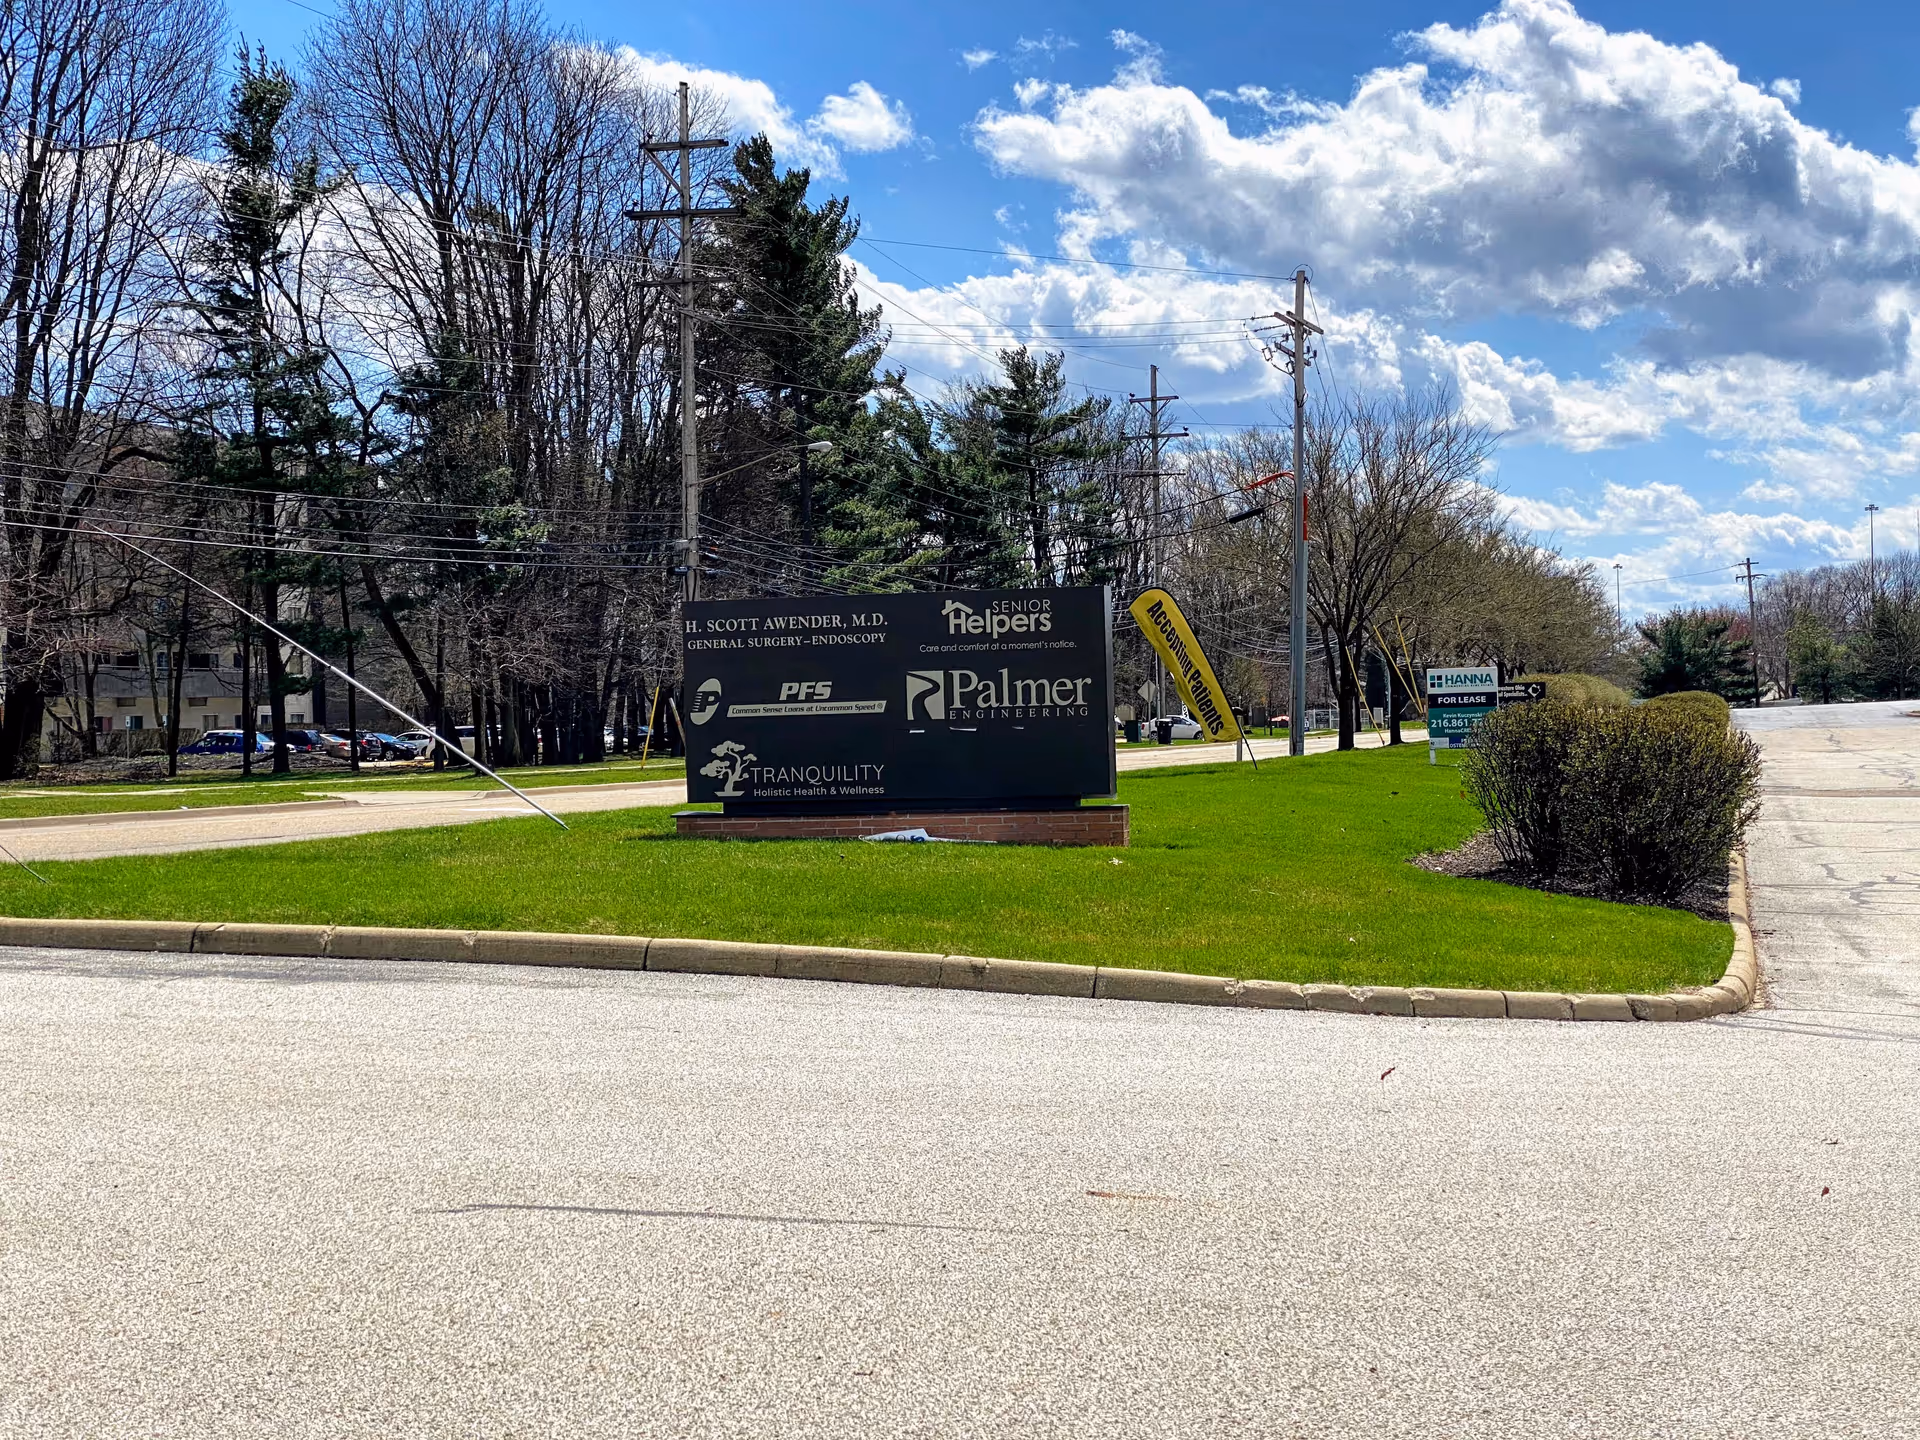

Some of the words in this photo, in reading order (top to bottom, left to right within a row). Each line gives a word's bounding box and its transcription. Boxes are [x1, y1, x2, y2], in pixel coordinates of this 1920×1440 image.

[992, 600, 1051, 613] SENIOR
[685, 620, 702, 633] H.
[706, 618, 760, 632] SCOTT
[763, 614, 847, 630] AWENDER,
[852, 613, 888, 627] M.D.
[949, 608, 1052, 639] Helpers
[687, 638, 744, 650] GENERAL
[919, 644, 939, 653] Care
[941, 643, 957, 652] and
[959, 642, 989, 652] comfort
[991, 642, 999, 650] at
[1008, 641, 1048, 650] moment's
[1049, 640, 1077, 649] notice.
[1146, 599, 1194, 679] Accepting
[1187, 669, 1224, 737] Patients
[1445, 673, 1494, 685] HANNA
[779, 681, 833, 701] PFS
[949, 668, 1092, 709] Palmer
[1437, 696, 1457, 704] FOR
[1458, 695, 1487, 704] LEASE
[731, 707, 761, 715] Common
[762, 706, 783, 714] Sense
[815, 704, 853, 712] Uncommon
[854, 703, 876, 712] Speed
[949, 706, 1089, 720] ENGINEERING
[750, 764, 885, 786] TRANQUILITY
[754, 787, 791, 797] Holistic
[793, 786, 827, 796] Health
[830, 786, 837, 795] &
[839, 786, 885, 795] Wellness
